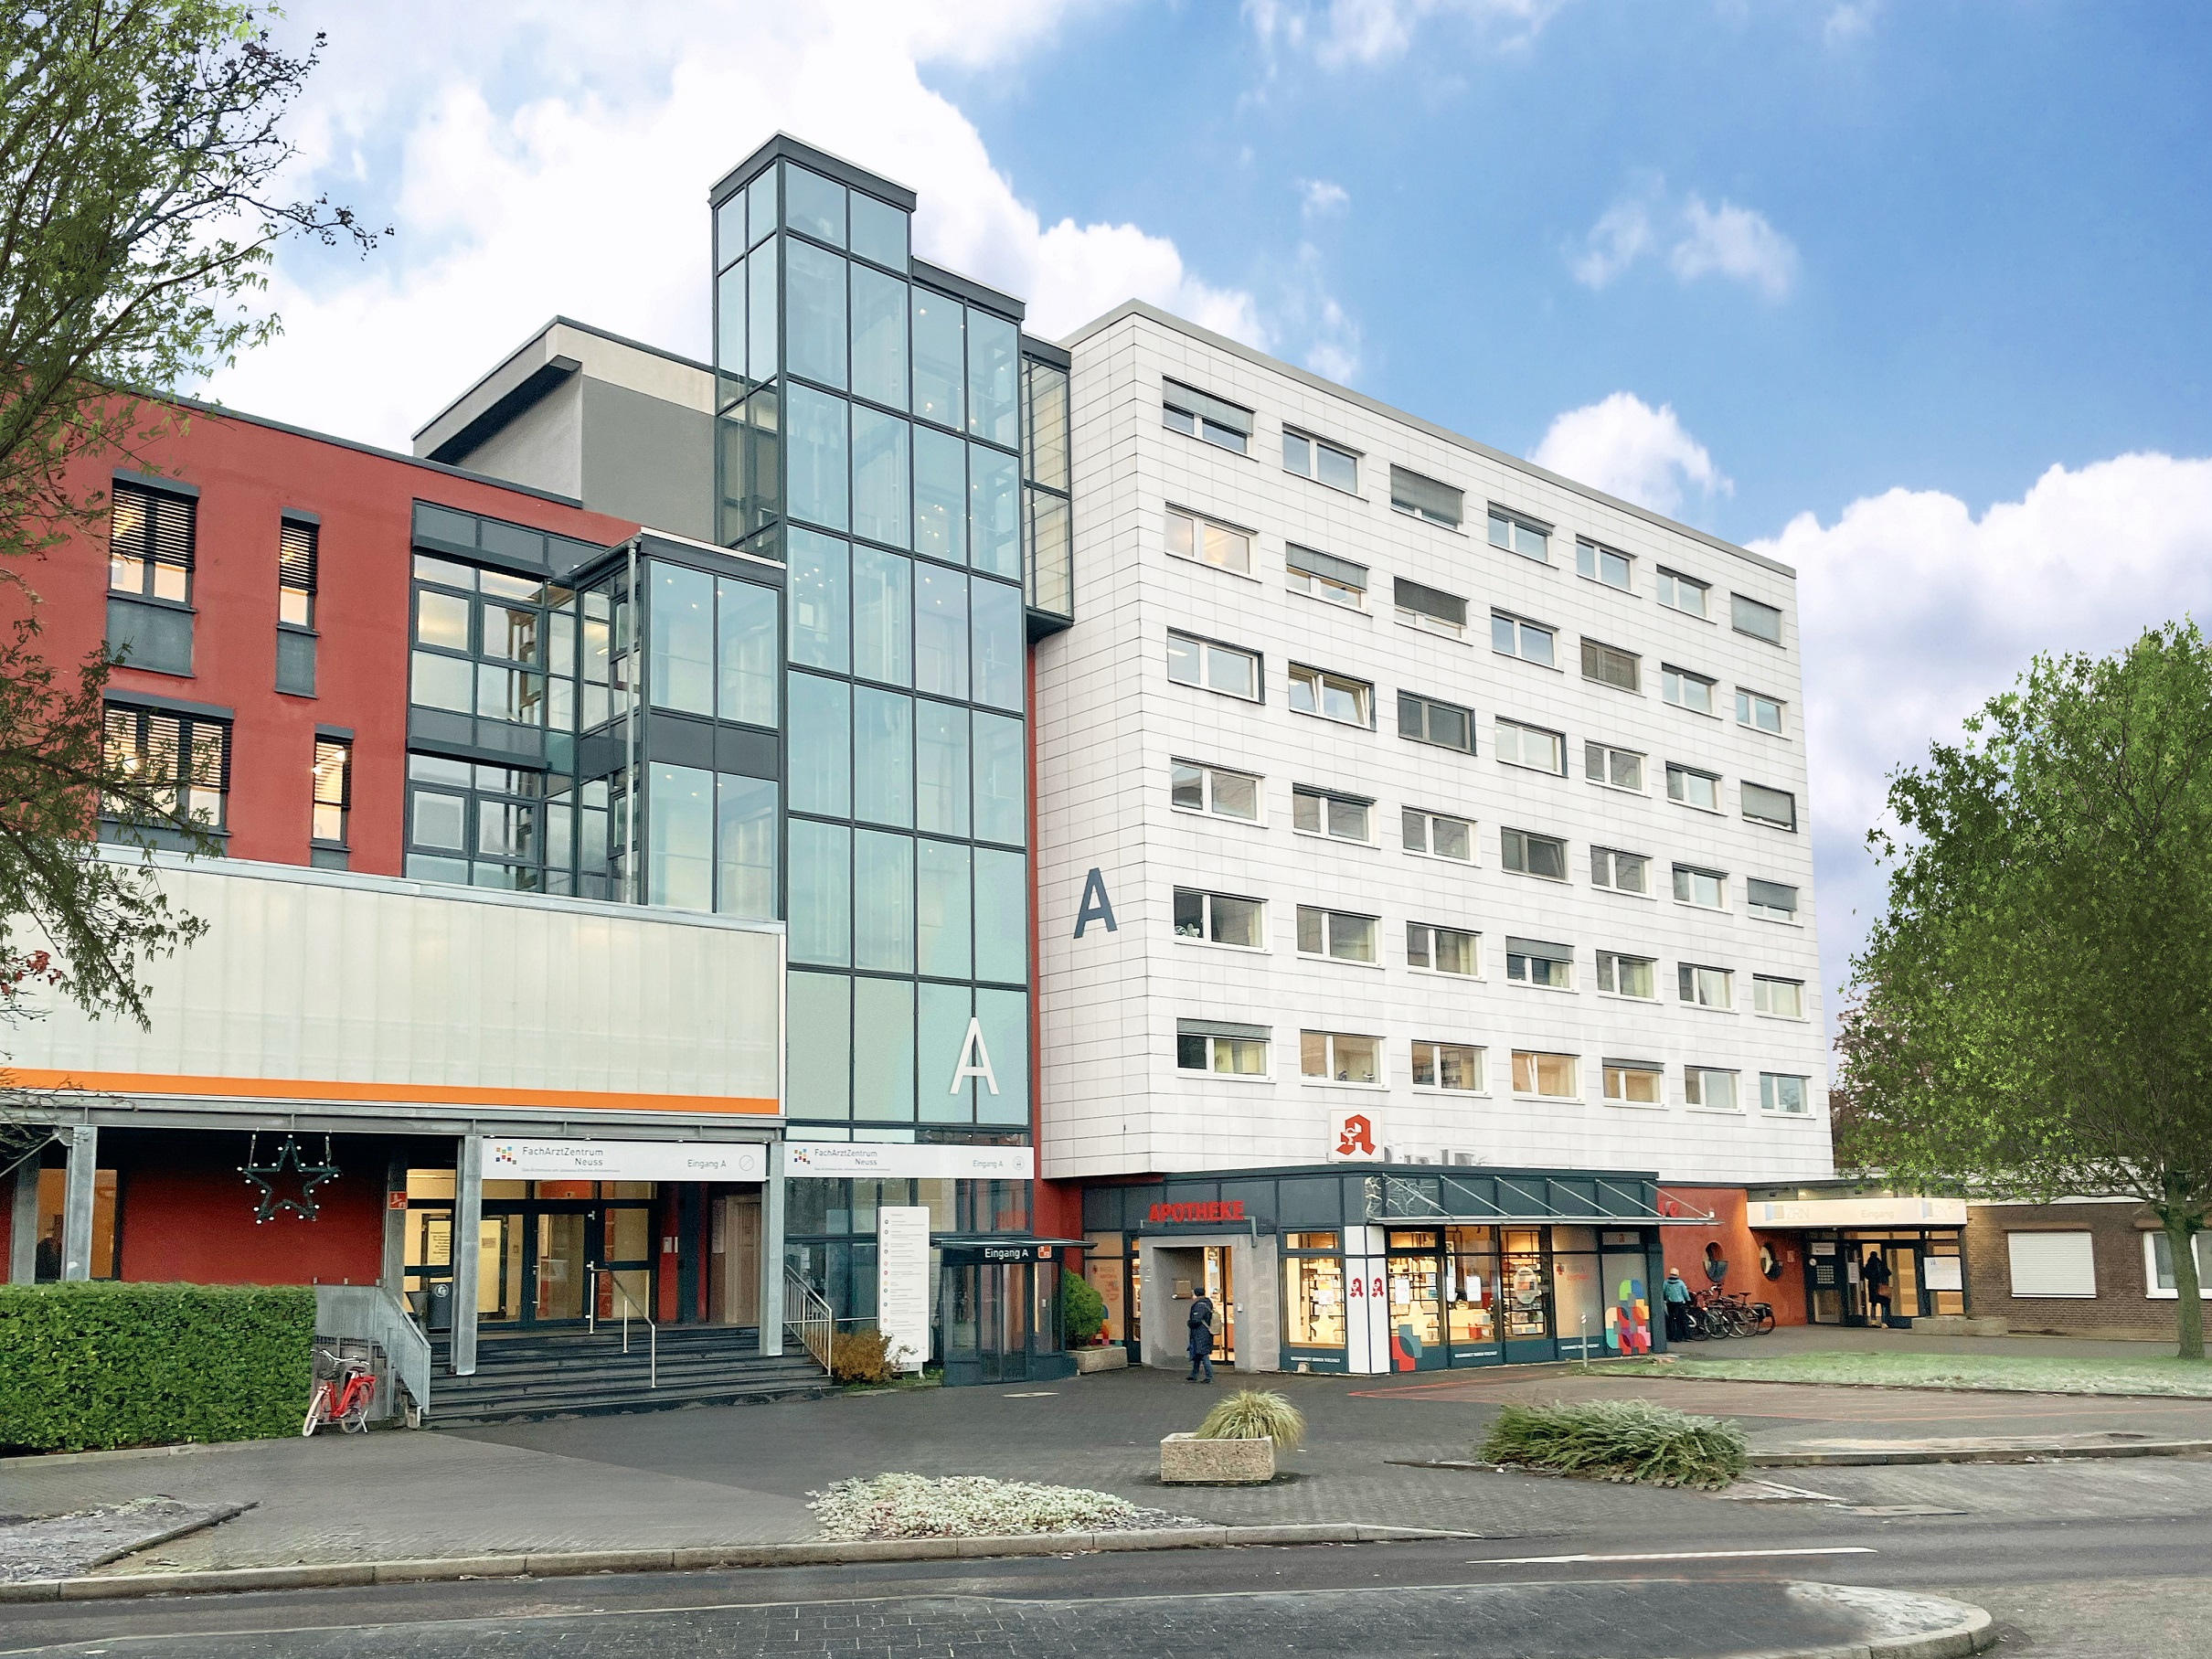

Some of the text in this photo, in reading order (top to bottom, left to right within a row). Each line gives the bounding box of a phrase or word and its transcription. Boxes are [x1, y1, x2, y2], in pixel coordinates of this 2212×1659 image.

[1073, 867, 1118, 940] A
[950, 1016, 1000, 1095] A
[522, 1146, 603, 1156] FachArztZentrum
[814, 1148, 877, 1157] FachArztZentrum
[574, 1157, 603, 1166] Neuss
[687, 1159, 718, 1170] Eingang
[855, 1157, 877, 1165] Neuss
[973, 1159, 997, 1169] Eingang
[1148, 1200, 1244, 1223] APOTHEKE
[1786, 1207, 1895, 1220] ZRN Eingang
[984, 1248, 1029, 1260] Eingang A
